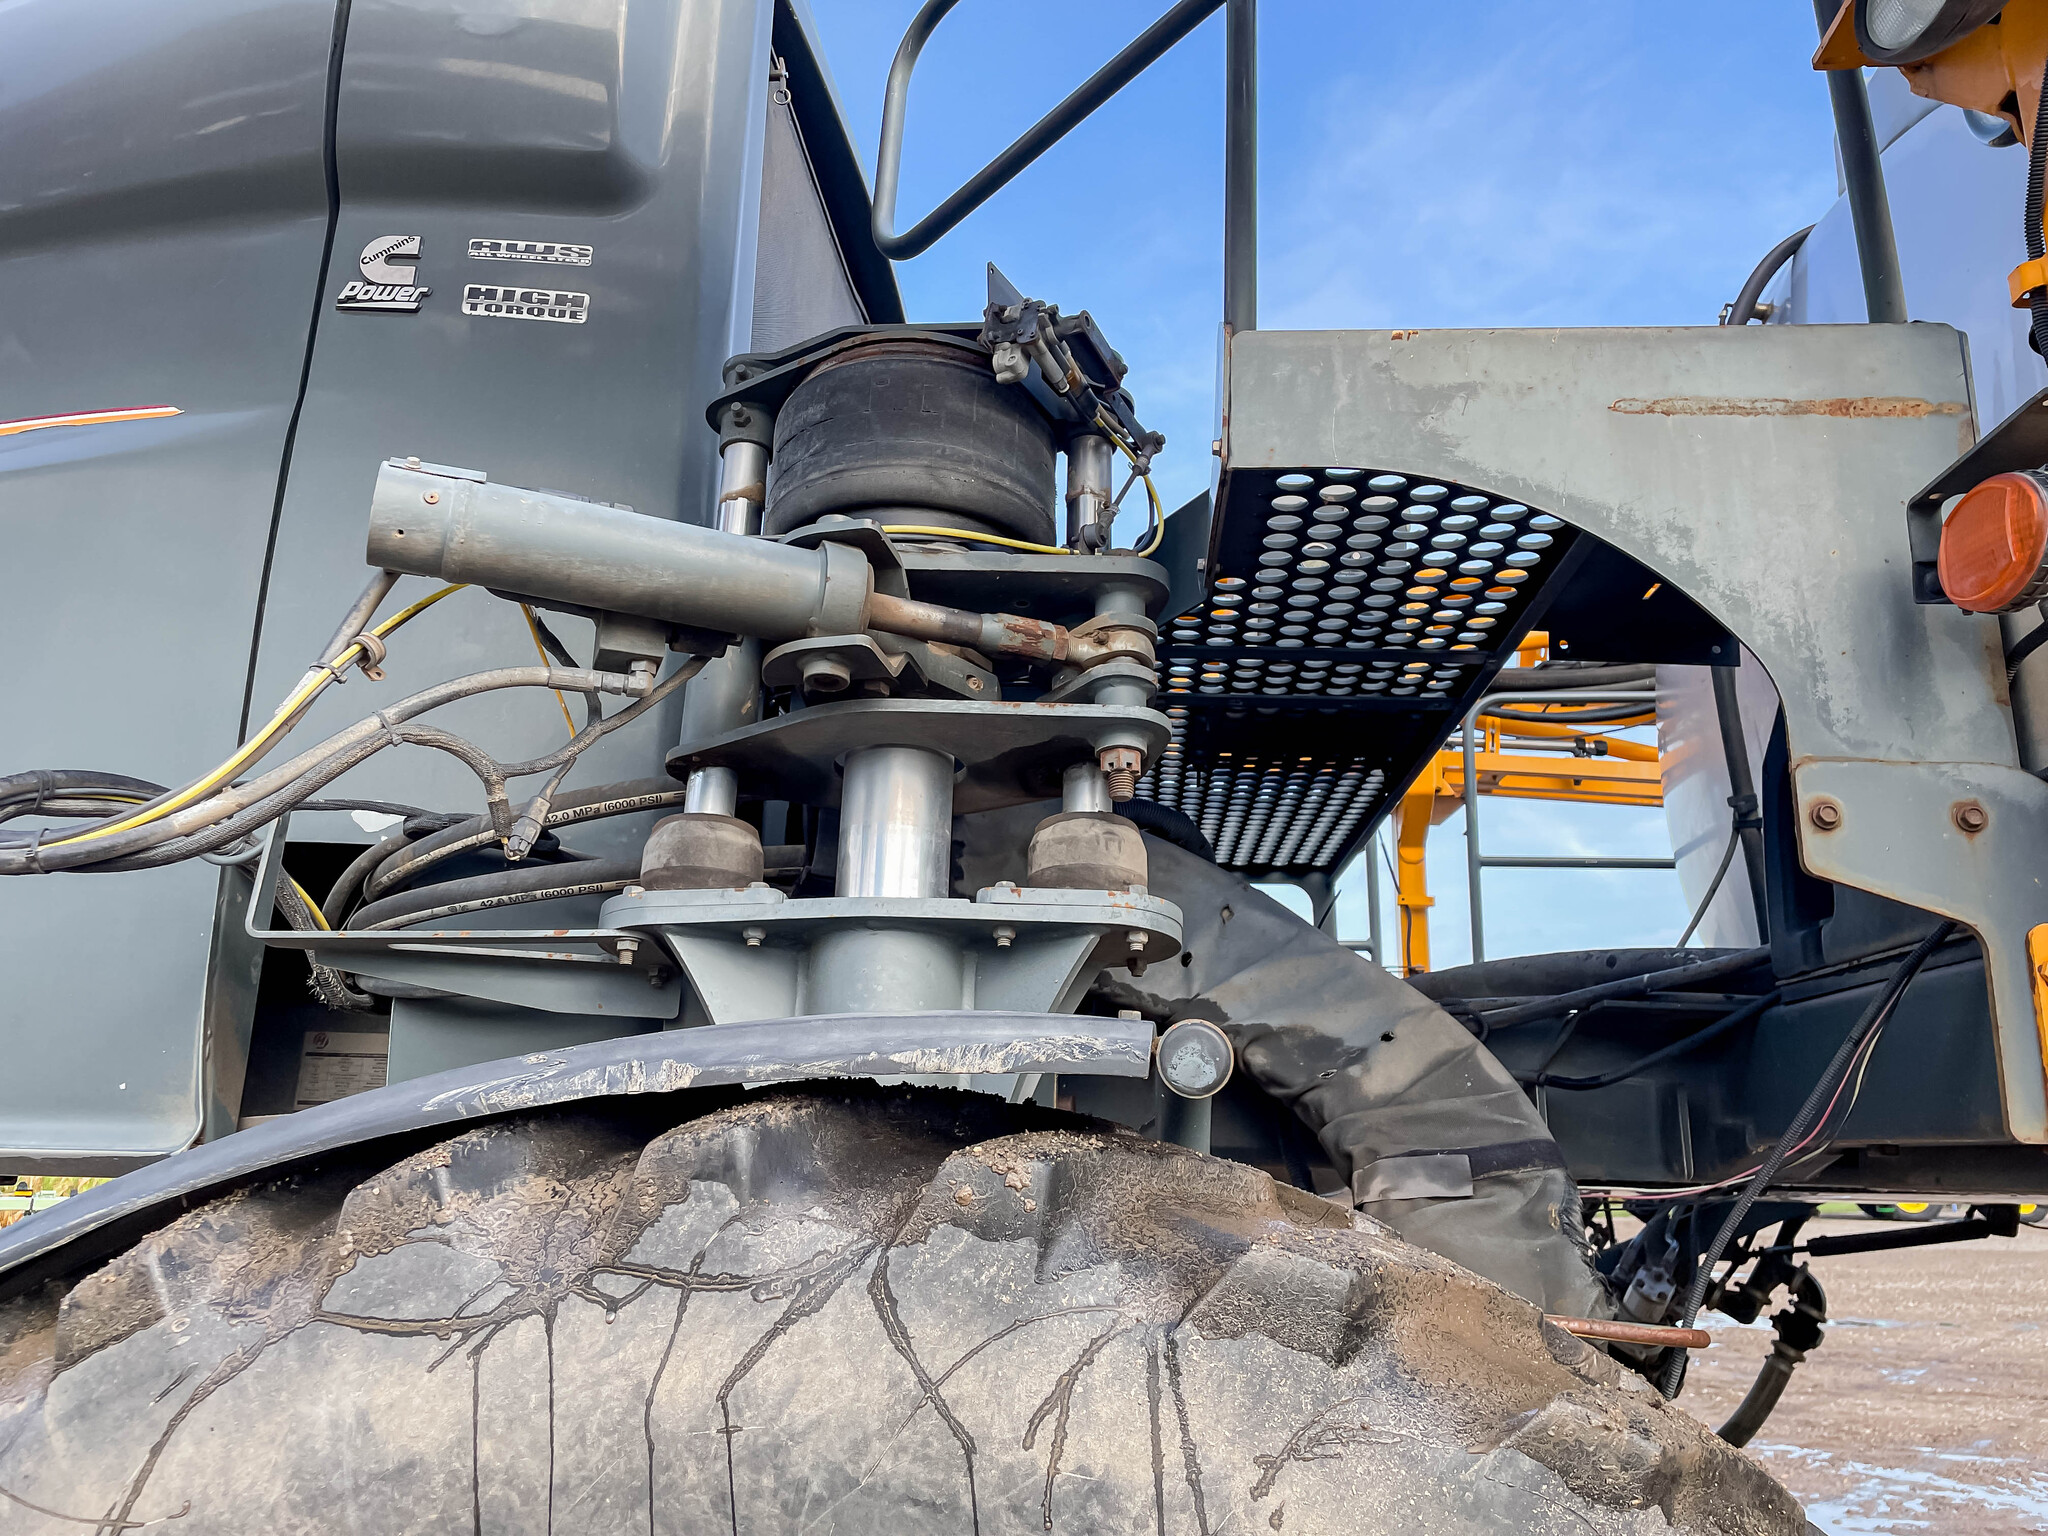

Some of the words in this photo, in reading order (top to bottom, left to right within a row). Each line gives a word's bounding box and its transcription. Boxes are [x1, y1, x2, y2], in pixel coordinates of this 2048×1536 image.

[361, 236, 416, 265] Cummins
[471, 241, 591, 257] AWS
[337, 280, 429, 302] Power
[467, 286, 586, 308] HIGH
[465, 302, 584, 320] TORQUE
[572, 806, 601, 819] MPa
[604, 799, 636, 813] (6000
[638, 793, 663, 805] PSI)
[540, 887, 574, 899] (6000
[577, 883, 604, 894] PSI)
